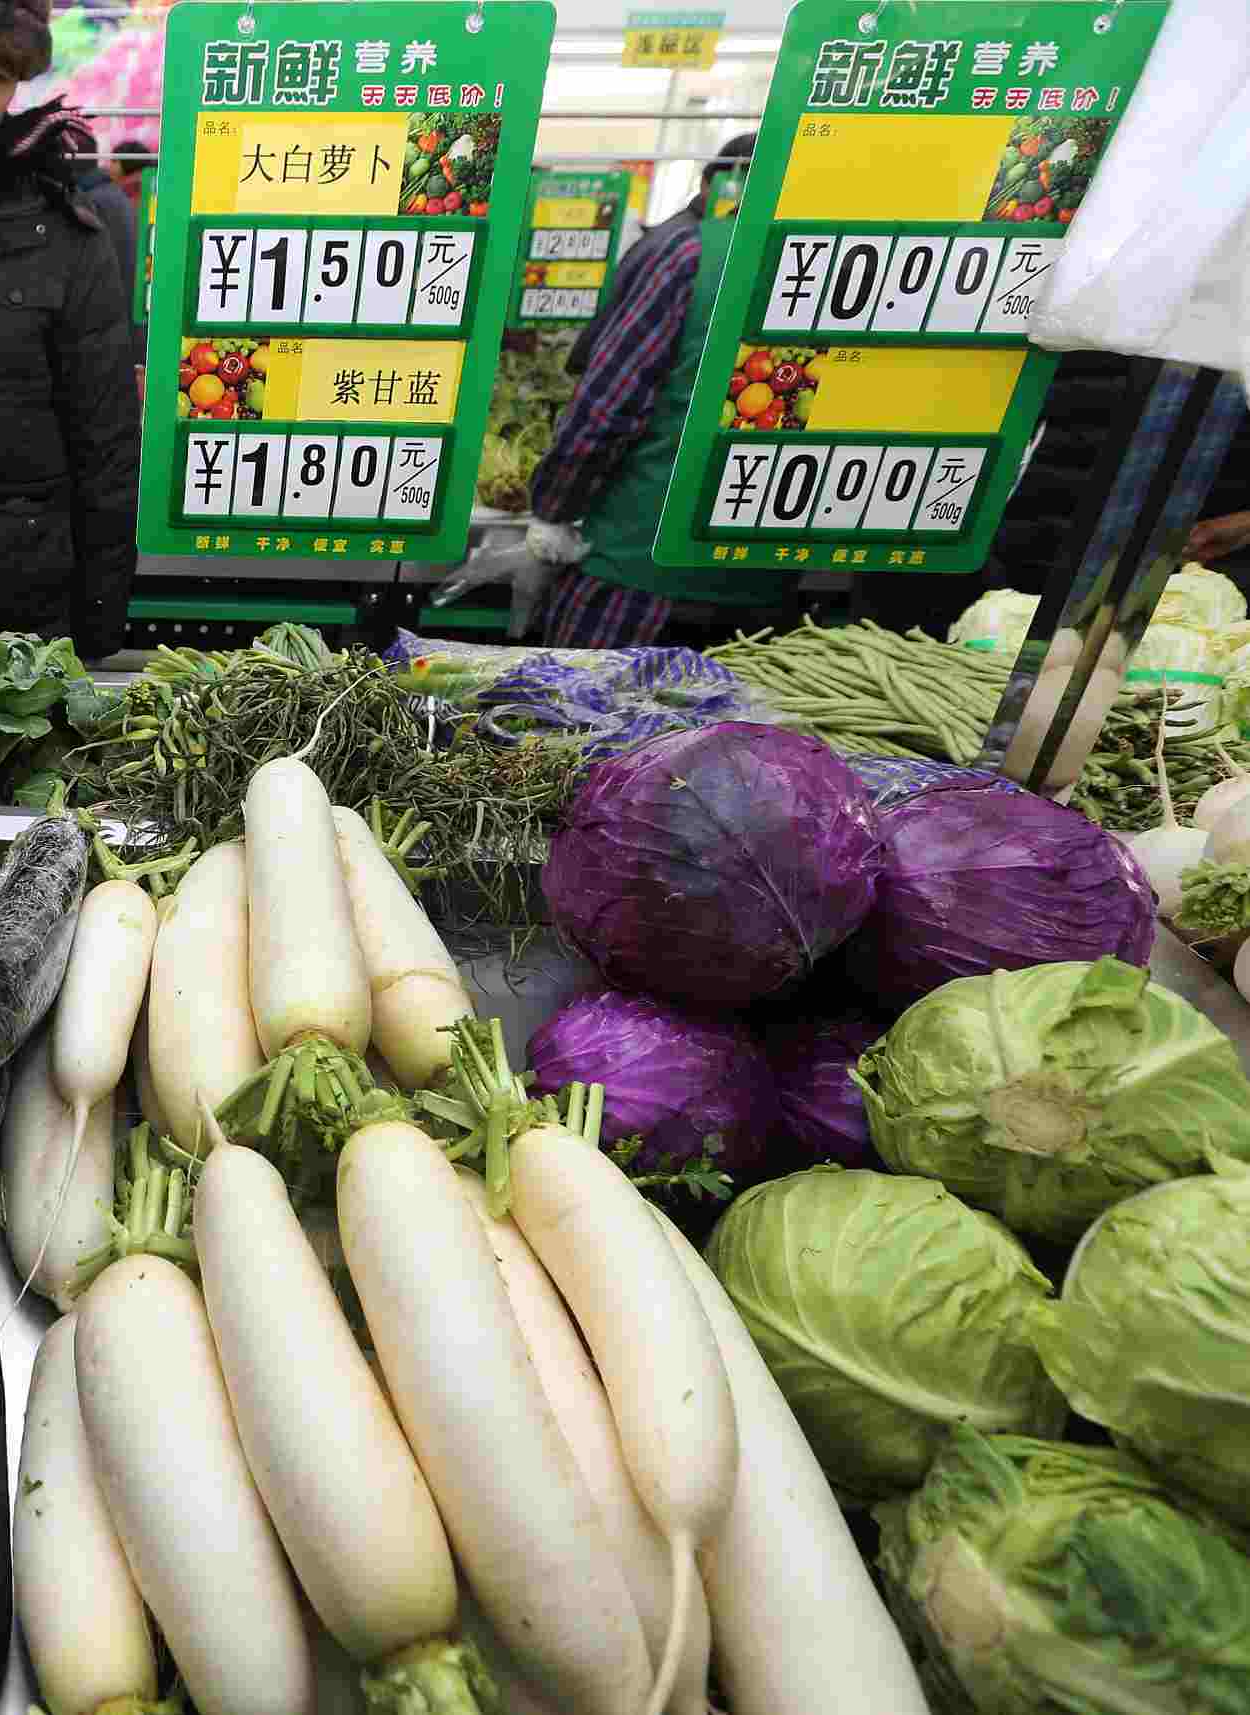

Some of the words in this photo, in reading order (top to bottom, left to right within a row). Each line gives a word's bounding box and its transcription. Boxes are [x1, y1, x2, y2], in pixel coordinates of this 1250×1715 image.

[354, 40, 440, 75] 营养
[970, 41, 1061, 77] 营养
[239, 143, 391, 185] 大白萝卜
[330, 370, 442, 406] 紫甘蓝
